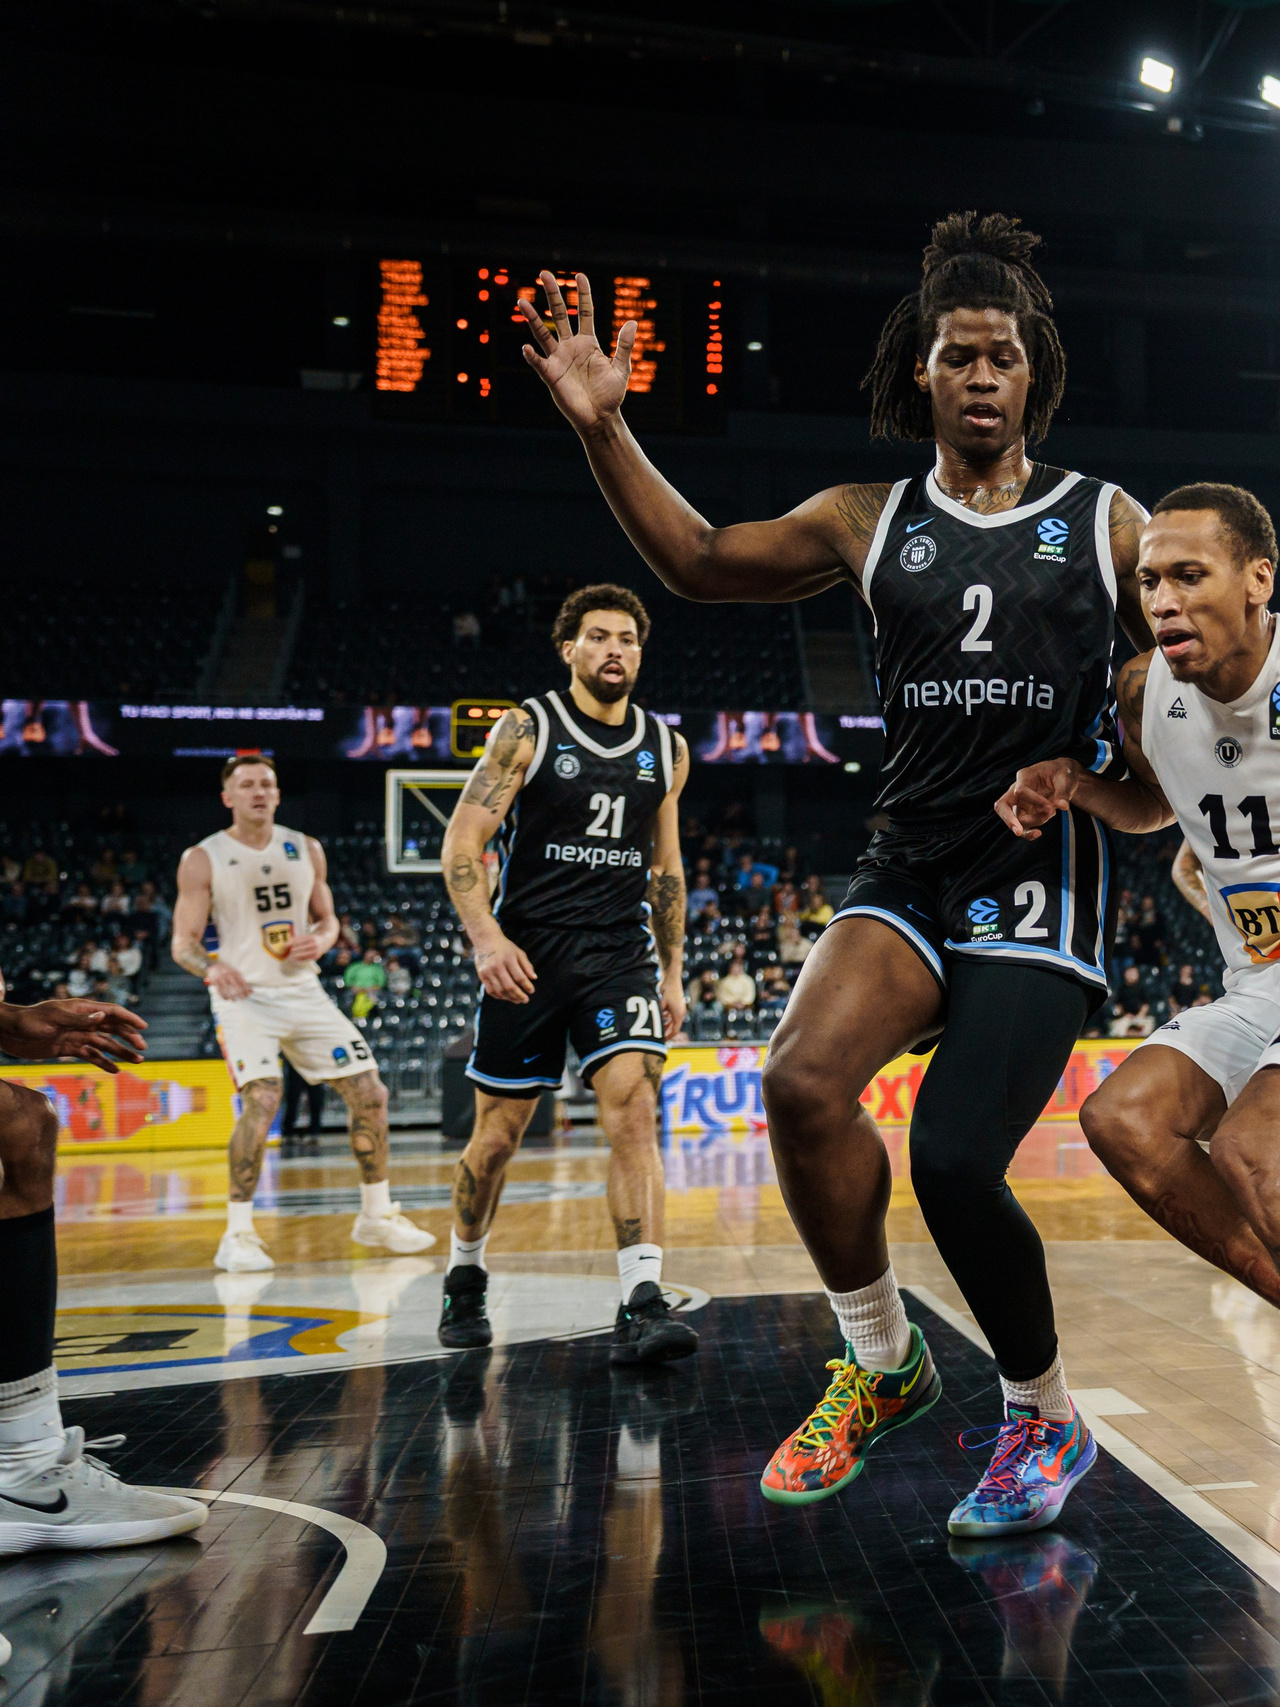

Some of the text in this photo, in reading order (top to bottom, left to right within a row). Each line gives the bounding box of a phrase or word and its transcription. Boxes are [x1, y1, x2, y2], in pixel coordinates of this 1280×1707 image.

[1033, 552, 1067, 564] EuroCup
[1038, 544, 1064, 554] BKT
[961, 584, 993, 652] 2
[904, 675, 1054, 715] nexperia
[1167, 710, 1188, 719] PEAK
[1222, 745, 1235, 762] U
[586, 792, 626, 838] 21
[1197, 794, 1280, 859] 11
[545, 843, 643, 869] nexperia
[254, 884, 292, 912] 55
[1014, 880, 1048, 938] 2
[971, 932, 1003, 943] EuroCup
[973, 924, 998, 935] BKT
[626, 996, 662, 1039] 21
[660, 1063, 766, 1134] FRUT
